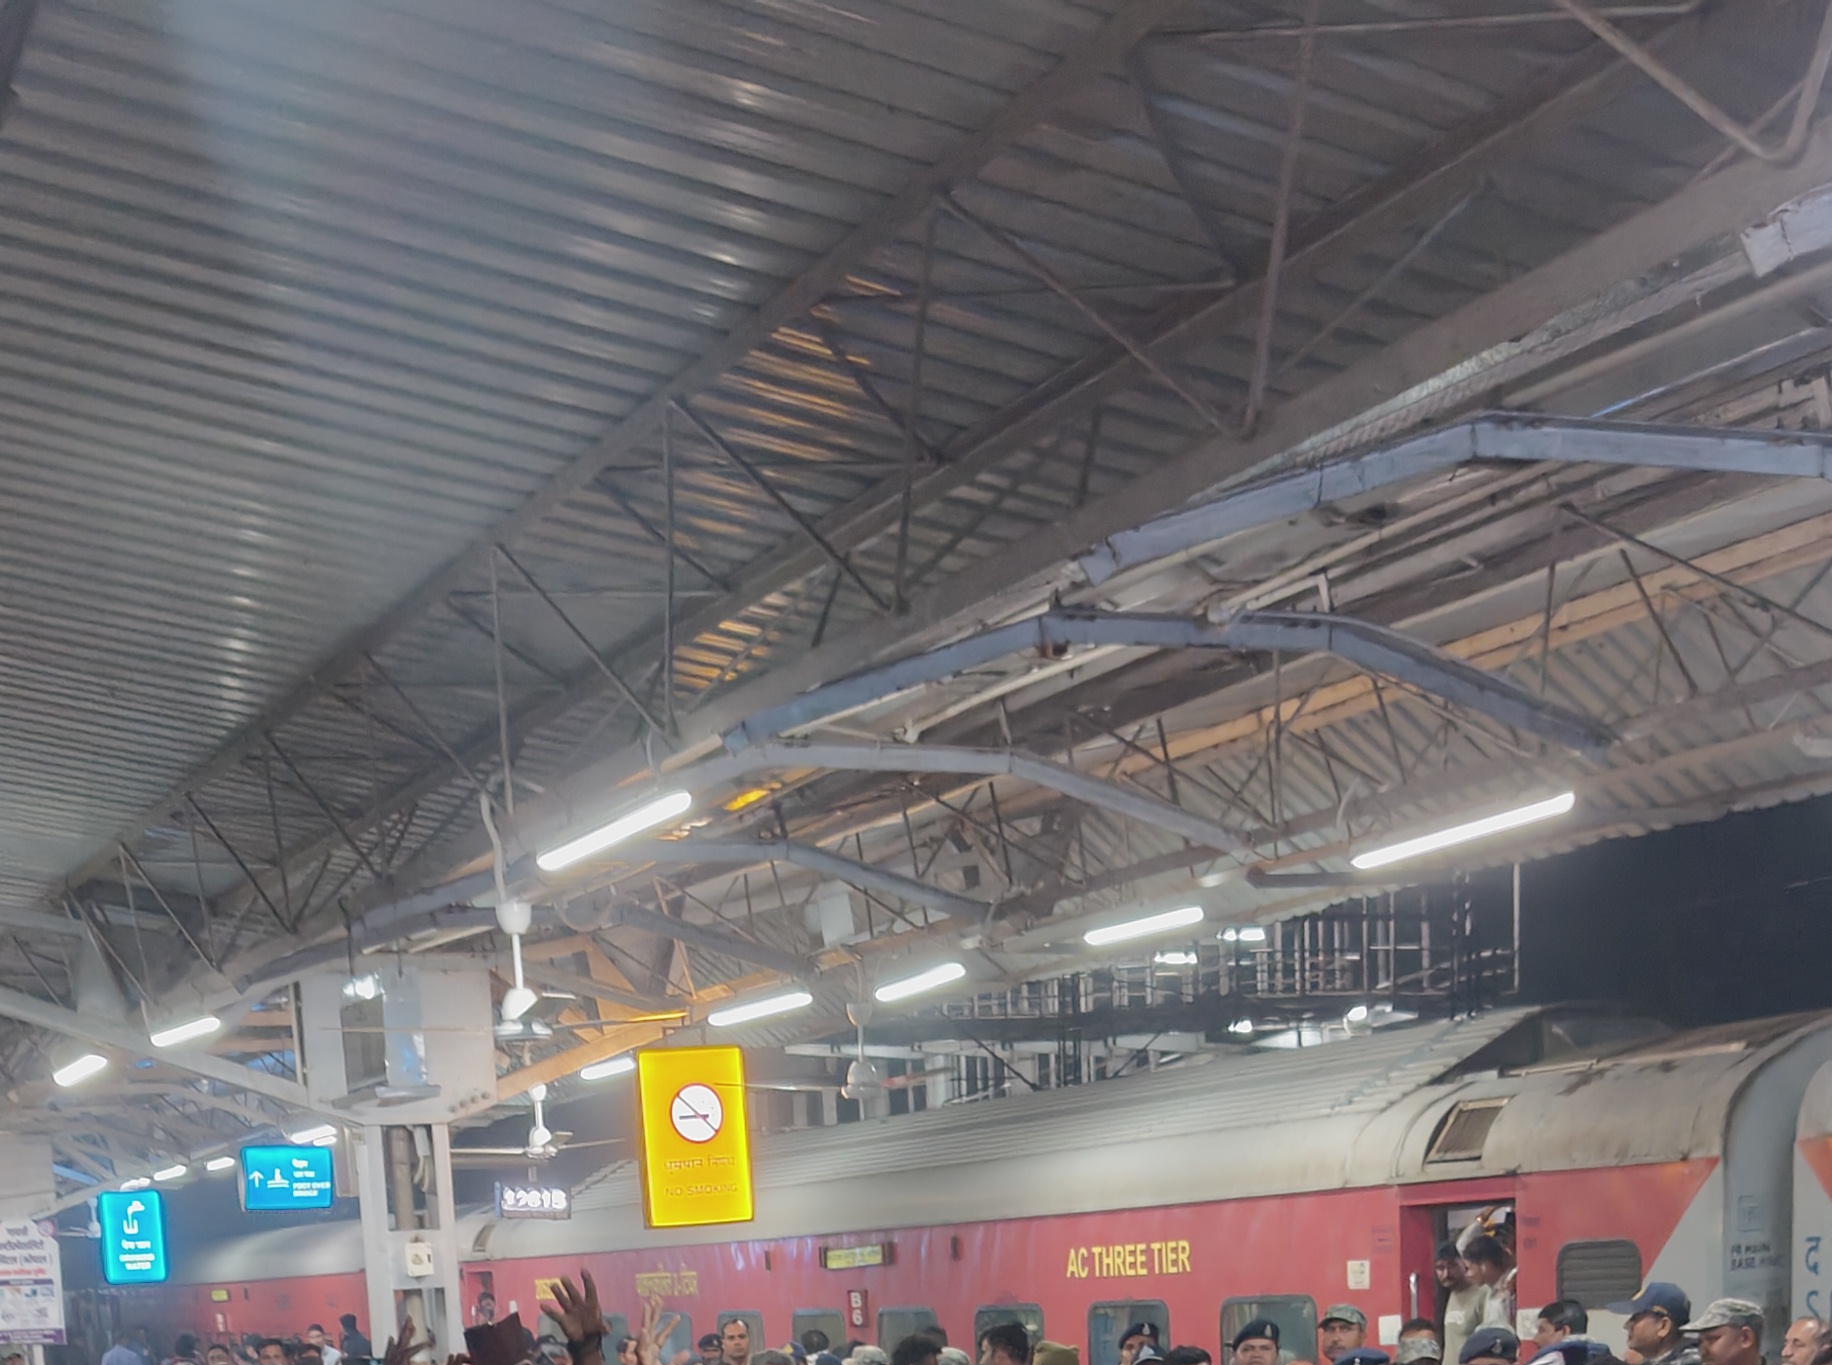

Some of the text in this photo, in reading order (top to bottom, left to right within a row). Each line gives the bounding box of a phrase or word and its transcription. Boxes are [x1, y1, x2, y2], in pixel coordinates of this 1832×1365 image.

[665, 1183, 738, 1197] NO SMOKING
[1066, 1240, 1191, 1279] AC THREE TIER
